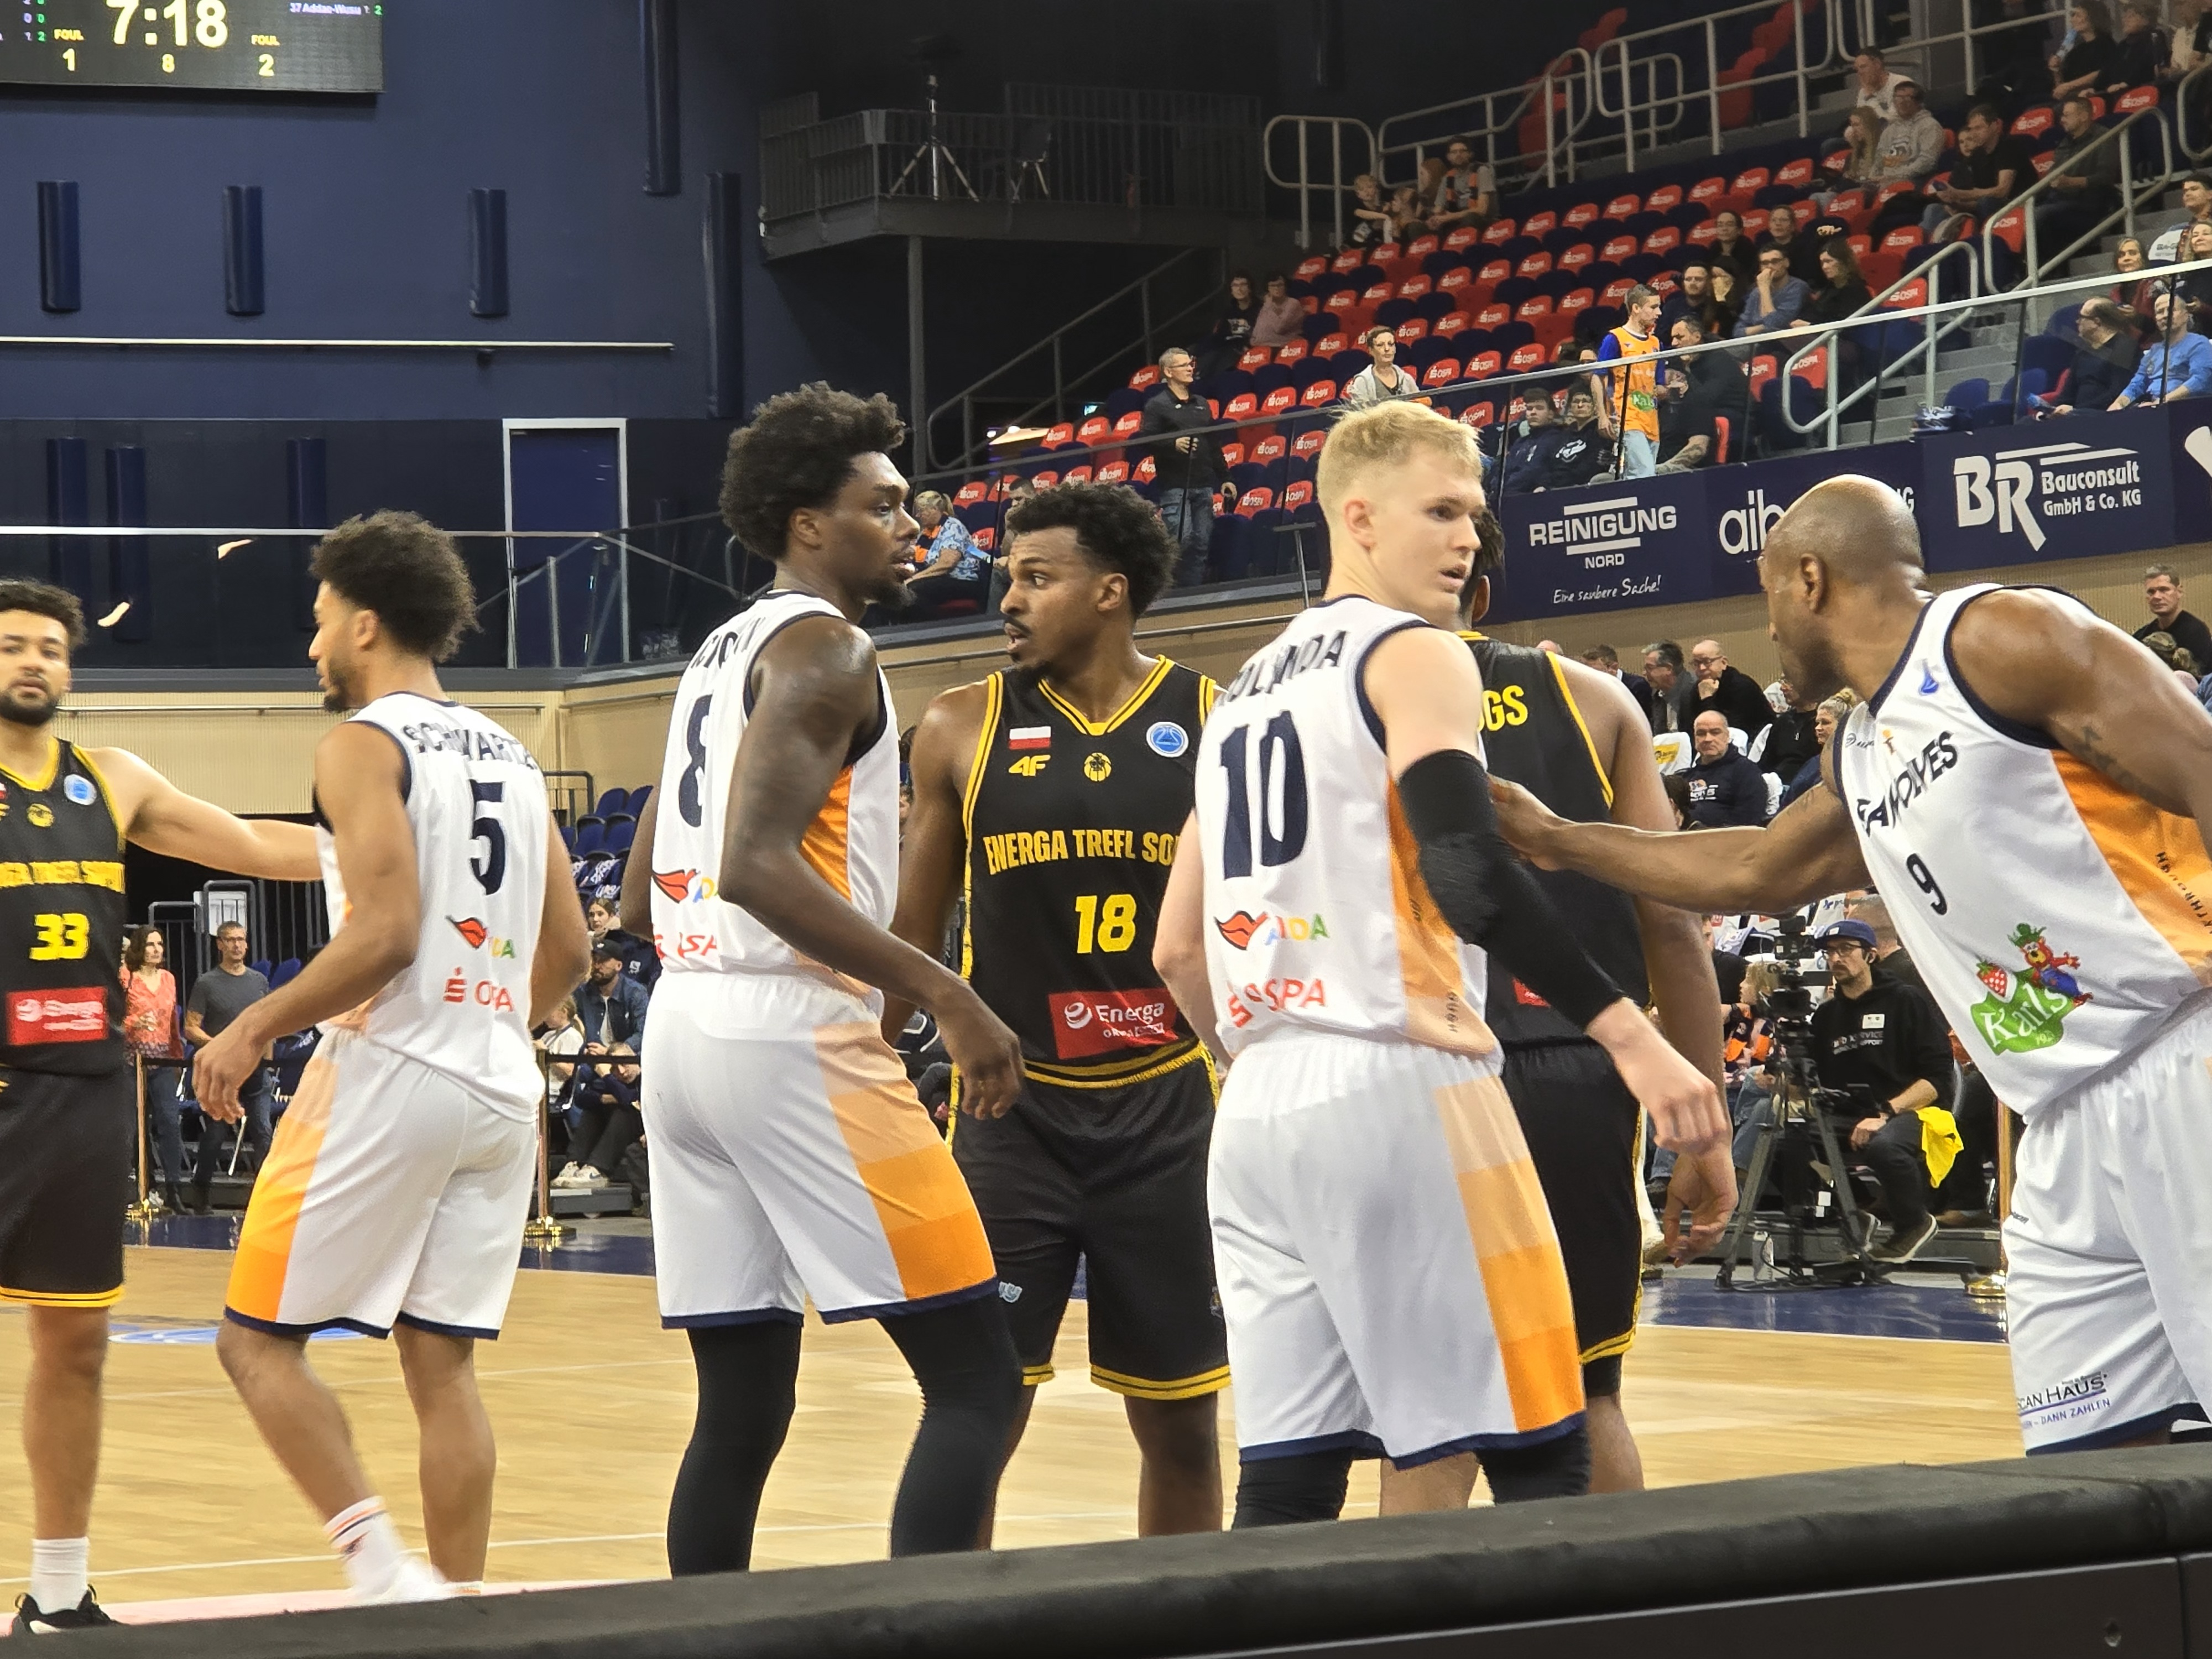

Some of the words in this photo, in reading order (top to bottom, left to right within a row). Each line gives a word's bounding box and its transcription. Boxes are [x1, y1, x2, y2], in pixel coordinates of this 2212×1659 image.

[374, 5, 383, 15] 2
[38, 31, 46, 41] 2
[54, 29, 84, 41] FOUL
[106, 0, 228, 48] 7:18
[251, 34, 280, 46] FOUL
[62, 48, 75, 71] 1
[162, 54, 175, 72] 8
[259, 54, 274, 77] 2
[2042, 461, 2140, 494] Bauconsult
[2043, 496, 2081, 516] GmbH
[2085, 495, 2096, 512] &
[2099, 494, 2119, 509] Co.
[2122, 489, 2142, 507] KG
[1529, 505, 1677, 547] REINIGUNG
[1584, 553, 1625, 569] NORD
[1577, 585, 1619, 602] saubere
[1621, 575, 1662, 597] Sache!
[1009, 754, 1051, 776] 4F
[1219, 709, 1308, 880] 10
[469, 778, 505, 895] 5
[983, 830, 1069, 875] ENERGA
[1072, 829, 1135, 858] TREFL
[1141, 832, 1181, 867] SO
[1906, 853, 1947, 916] 9
[29, 913, 90, 961] 33
[1075, 893, 1138, 954] 18
[1095, 1003, 1165, 1025] Energa
[1980, 983, 2068, 1047] Karls
[2046, 1376, 2105, 1403] HAUS
[2041, 1410, 2067, 1425] DANN
